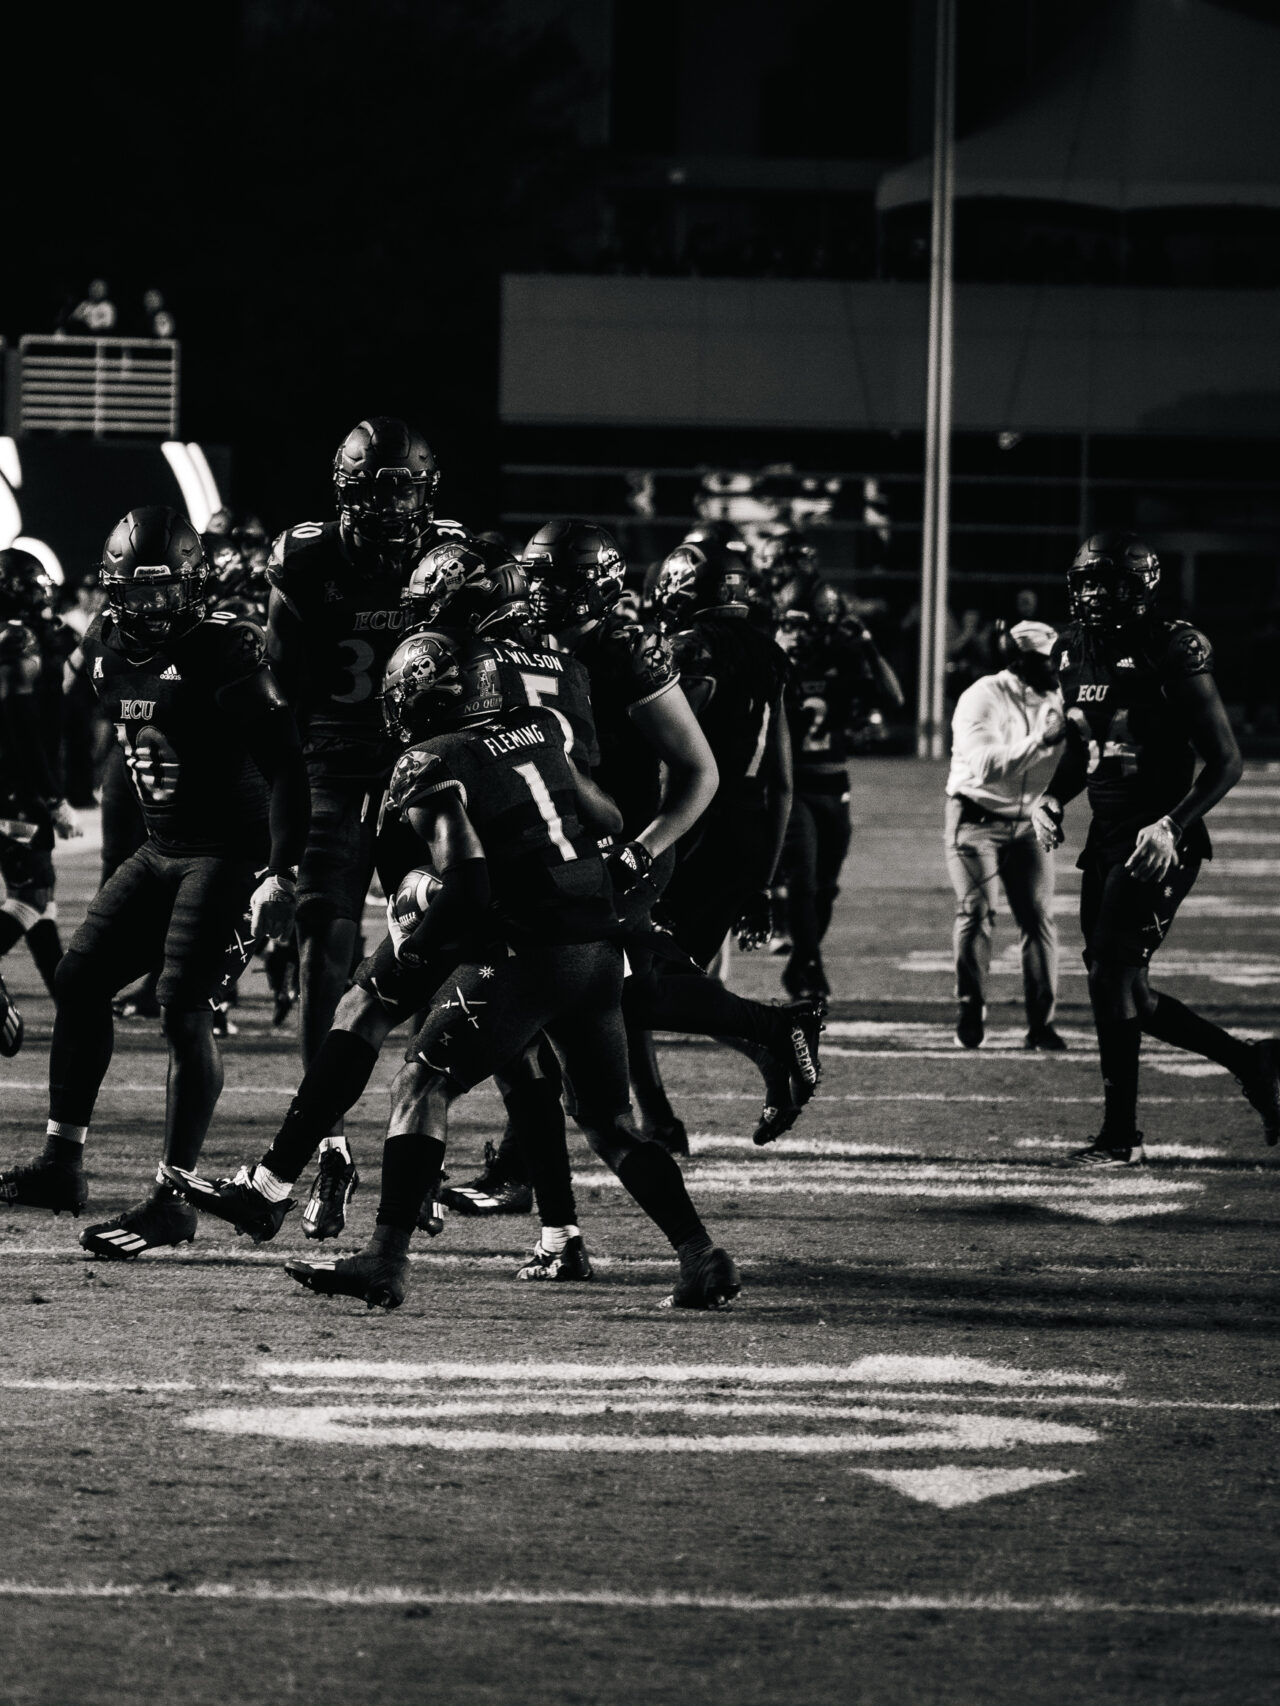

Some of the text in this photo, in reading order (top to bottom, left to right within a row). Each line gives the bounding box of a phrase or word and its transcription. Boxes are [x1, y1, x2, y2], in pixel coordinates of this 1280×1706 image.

[353, 610, 403, 631] ECU
[330, 639, 375, 703] 3
[1076, 685, 1110, 702] ECU
[120, 699, 156, 720] ECU
[483, 723, 545, 757] FLEMING
[512, 760, 578, 862] 1
